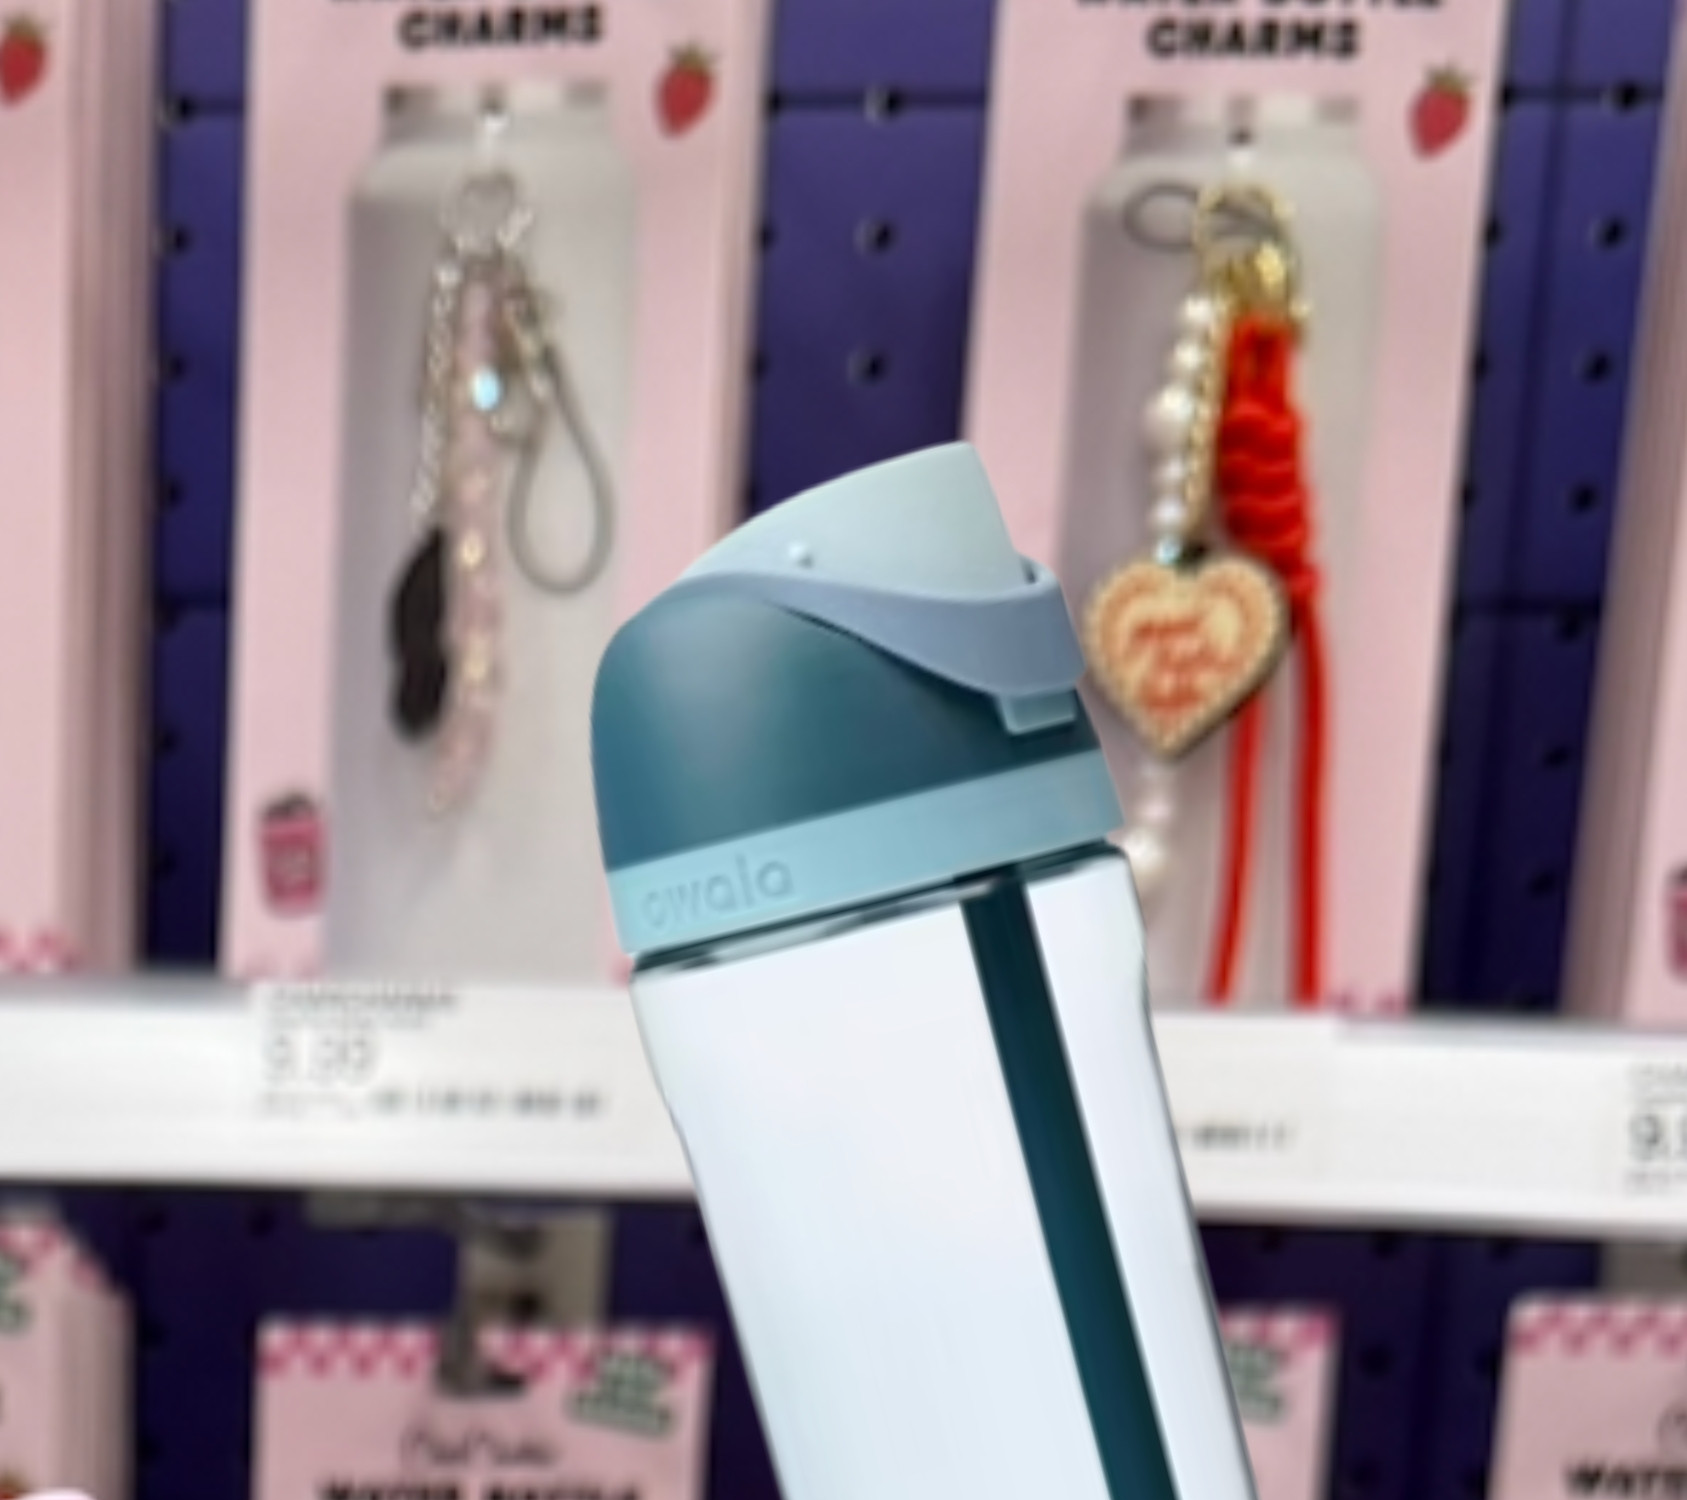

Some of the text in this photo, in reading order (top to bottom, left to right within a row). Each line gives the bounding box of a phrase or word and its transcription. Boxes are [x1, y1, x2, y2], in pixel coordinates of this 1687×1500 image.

[398, 6, 604, 50] CHARMS
[1145, 17, 1361, 60] CHARMS
[640, 850, 796, 932] owala
